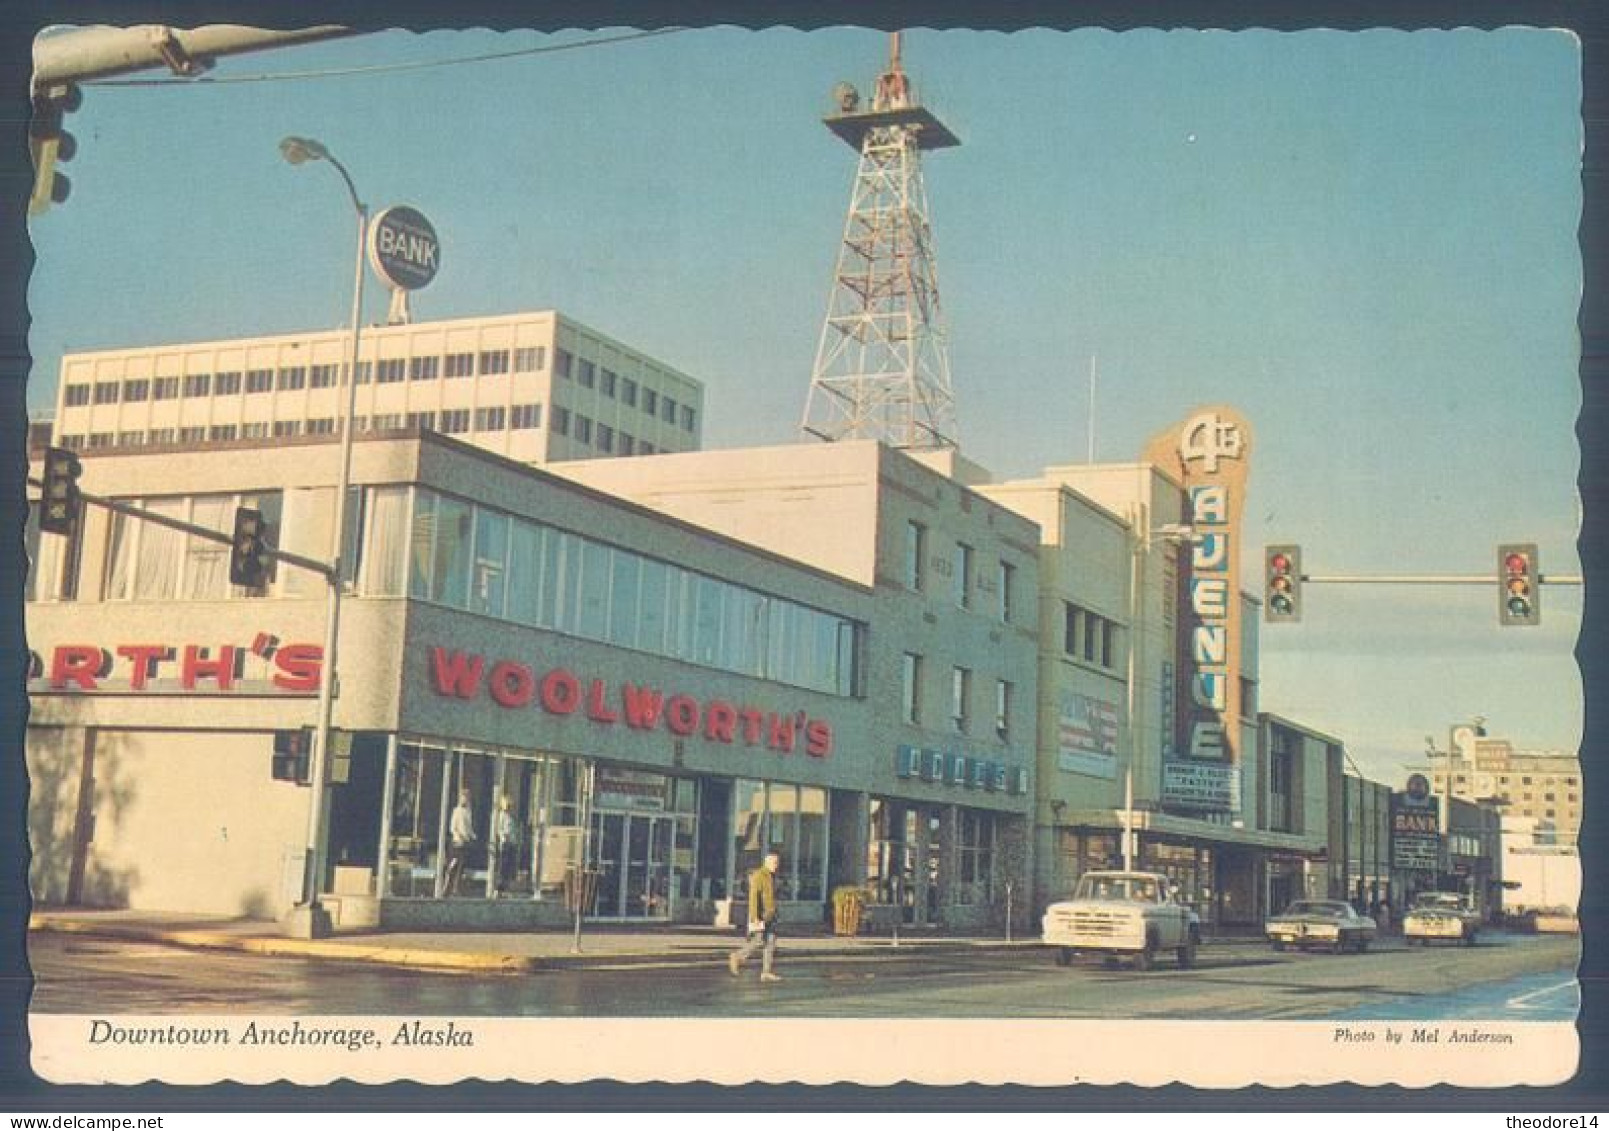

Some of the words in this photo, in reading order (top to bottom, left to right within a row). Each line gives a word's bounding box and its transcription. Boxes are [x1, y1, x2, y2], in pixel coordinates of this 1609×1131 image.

[380, 226, 436, 270] BANK
[30, 632, 325, 692] RTH'S
[430, 646, 834, 758] WOOLWORTH'S
